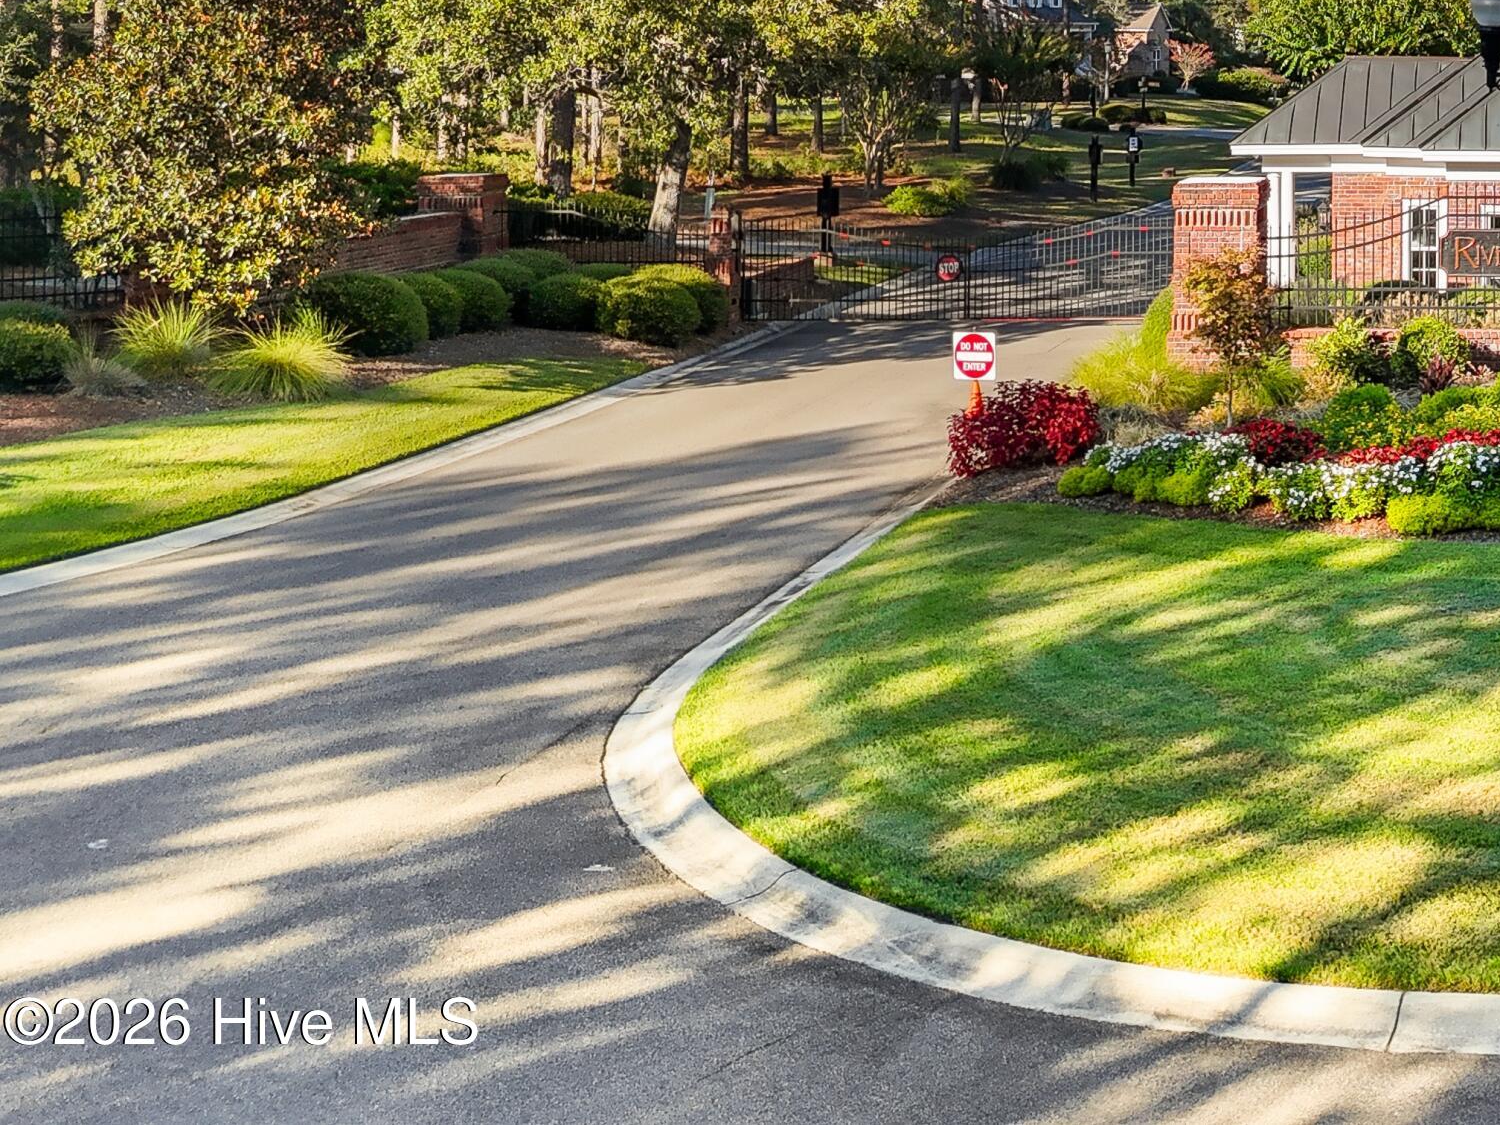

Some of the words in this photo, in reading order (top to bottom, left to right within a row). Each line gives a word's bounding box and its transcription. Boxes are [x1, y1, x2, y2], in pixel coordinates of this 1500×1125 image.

[939, 261, 960, 274] STOP
[960, 342, 971, 351] DO
[973, 342, 988, 351] NOT
[963, 362, 986, 371] ENTER
